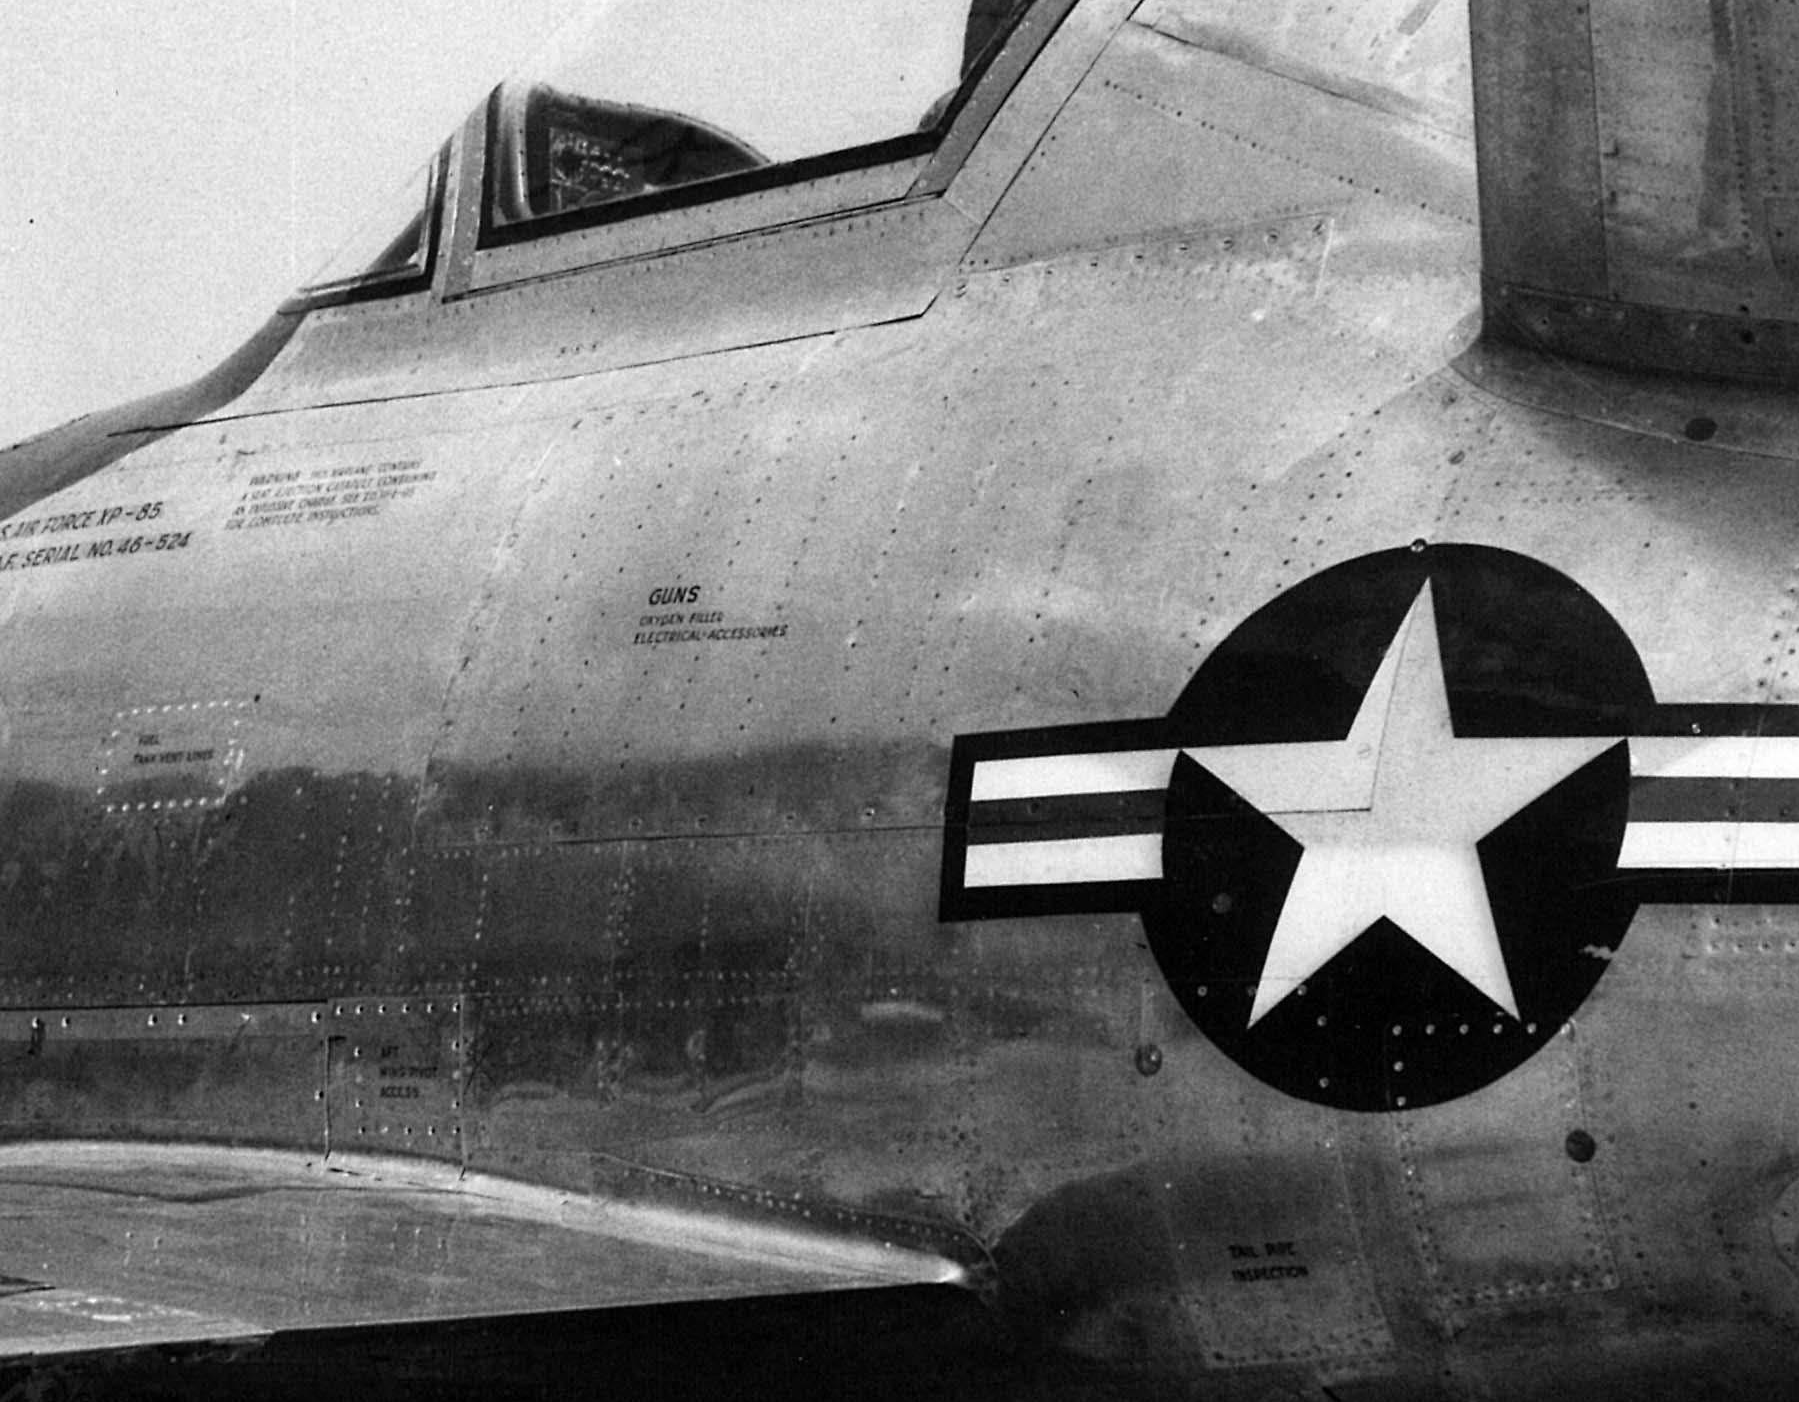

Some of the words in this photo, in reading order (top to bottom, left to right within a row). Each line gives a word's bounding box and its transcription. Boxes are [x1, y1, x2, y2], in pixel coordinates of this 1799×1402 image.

[41, 509, 97, 536] FORCE
[96, 500, 165, 527] XP-85
[21, 543, 80, 569] SERIAL
[116, 530, 194, 555] 46-524
[649, 585, 702, 606] GUNS
[639, 612, 685, 628] OXYGEN
[380, 1085, 420, 1100] ACCESS
[1228, 1244, 1259, 1259] TAIL
[1231, 1265, 1309, 1283] INSPECTION
